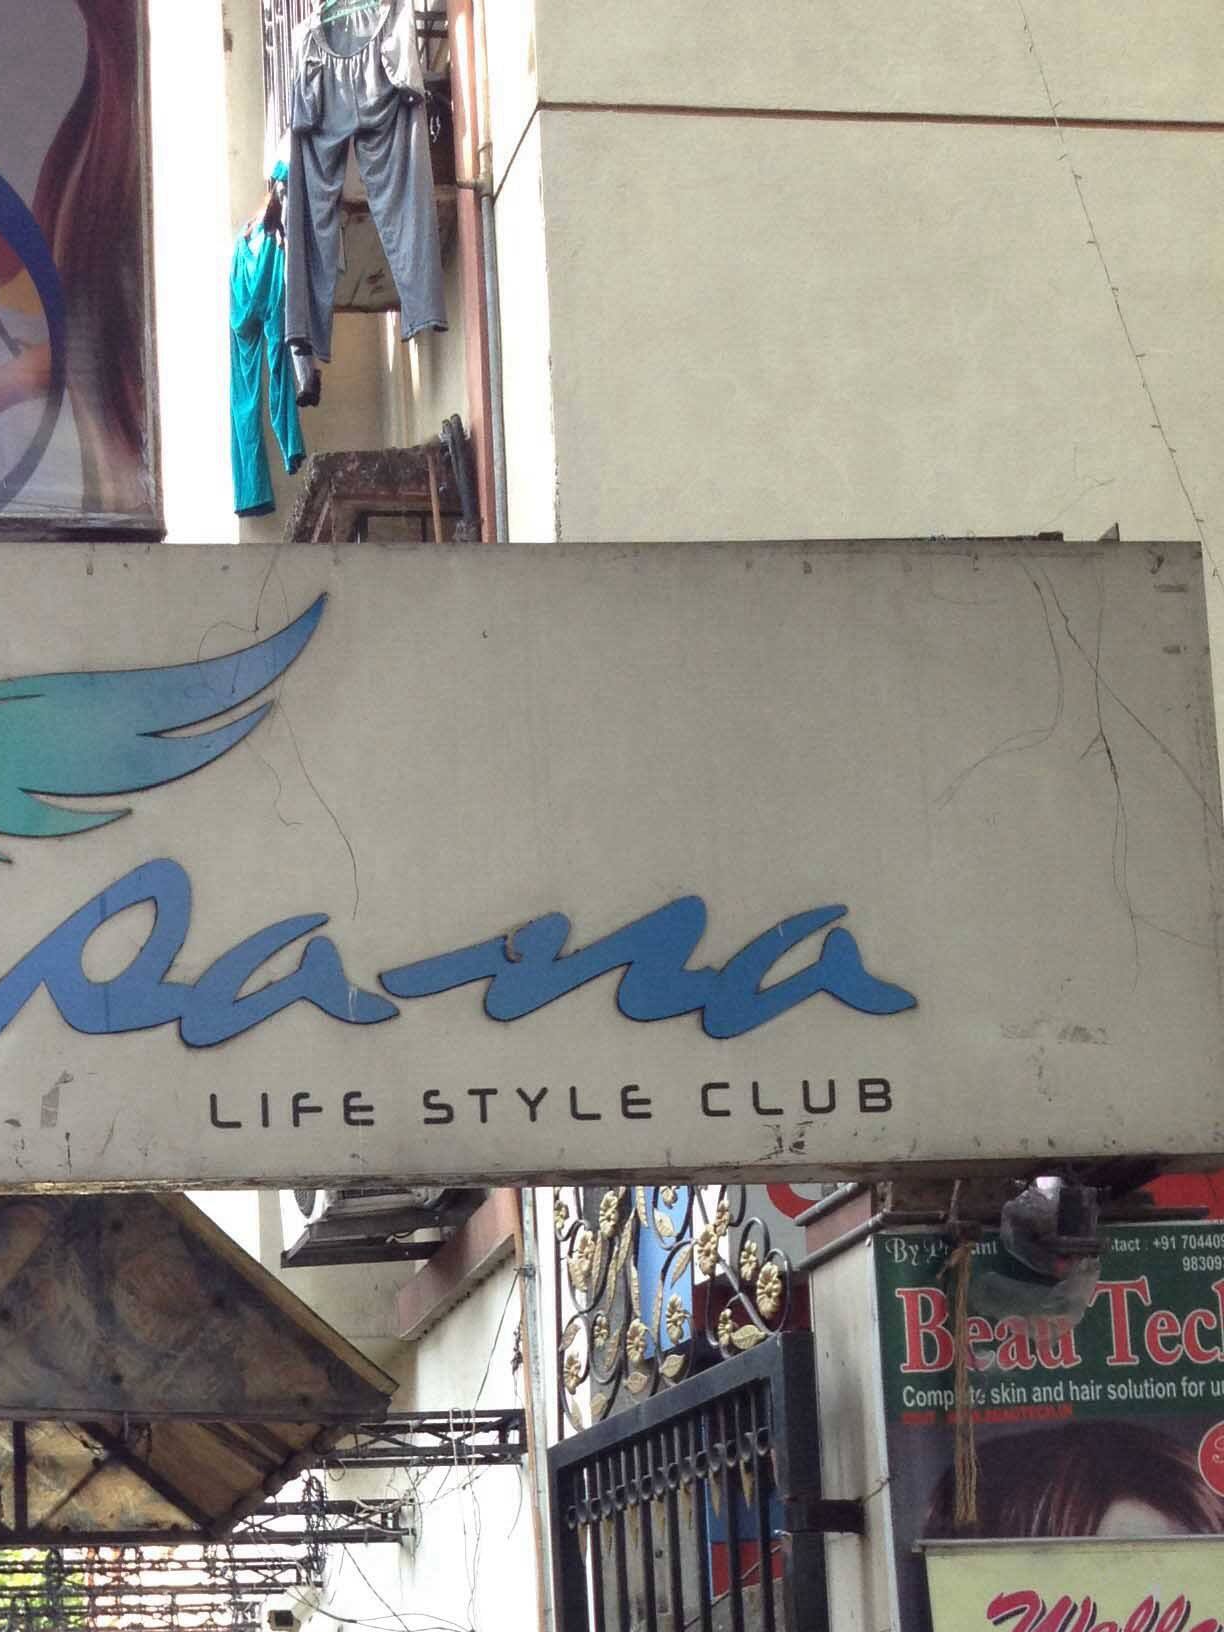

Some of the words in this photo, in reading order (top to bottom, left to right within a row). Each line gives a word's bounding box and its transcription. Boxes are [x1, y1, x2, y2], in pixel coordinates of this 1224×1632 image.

[209, 1090, 376, 1128] LIFE
[423, 1084, 652, 1124] STYLE
[701, 1077, 894, 1116] CLUB
[885, 1237, 919, 1265] By
[923, 1238, 998, 1264] Prant
[1153, 1236, 1176, 1250] +91
[895, 1288, 1082, 1373] Beau
[1087, 1275, 1224, 1367] Tec
[902, 1385, 986, 1412] Compte
[990, 1383, 1026, 1403] skin
[1032, 1381, 1064, 1402] and
[1069, 1379, 1102, 1401] hair
[1107, 1376, 1176, 1400] solution
[1181, 1376, 1205, 1397] for
